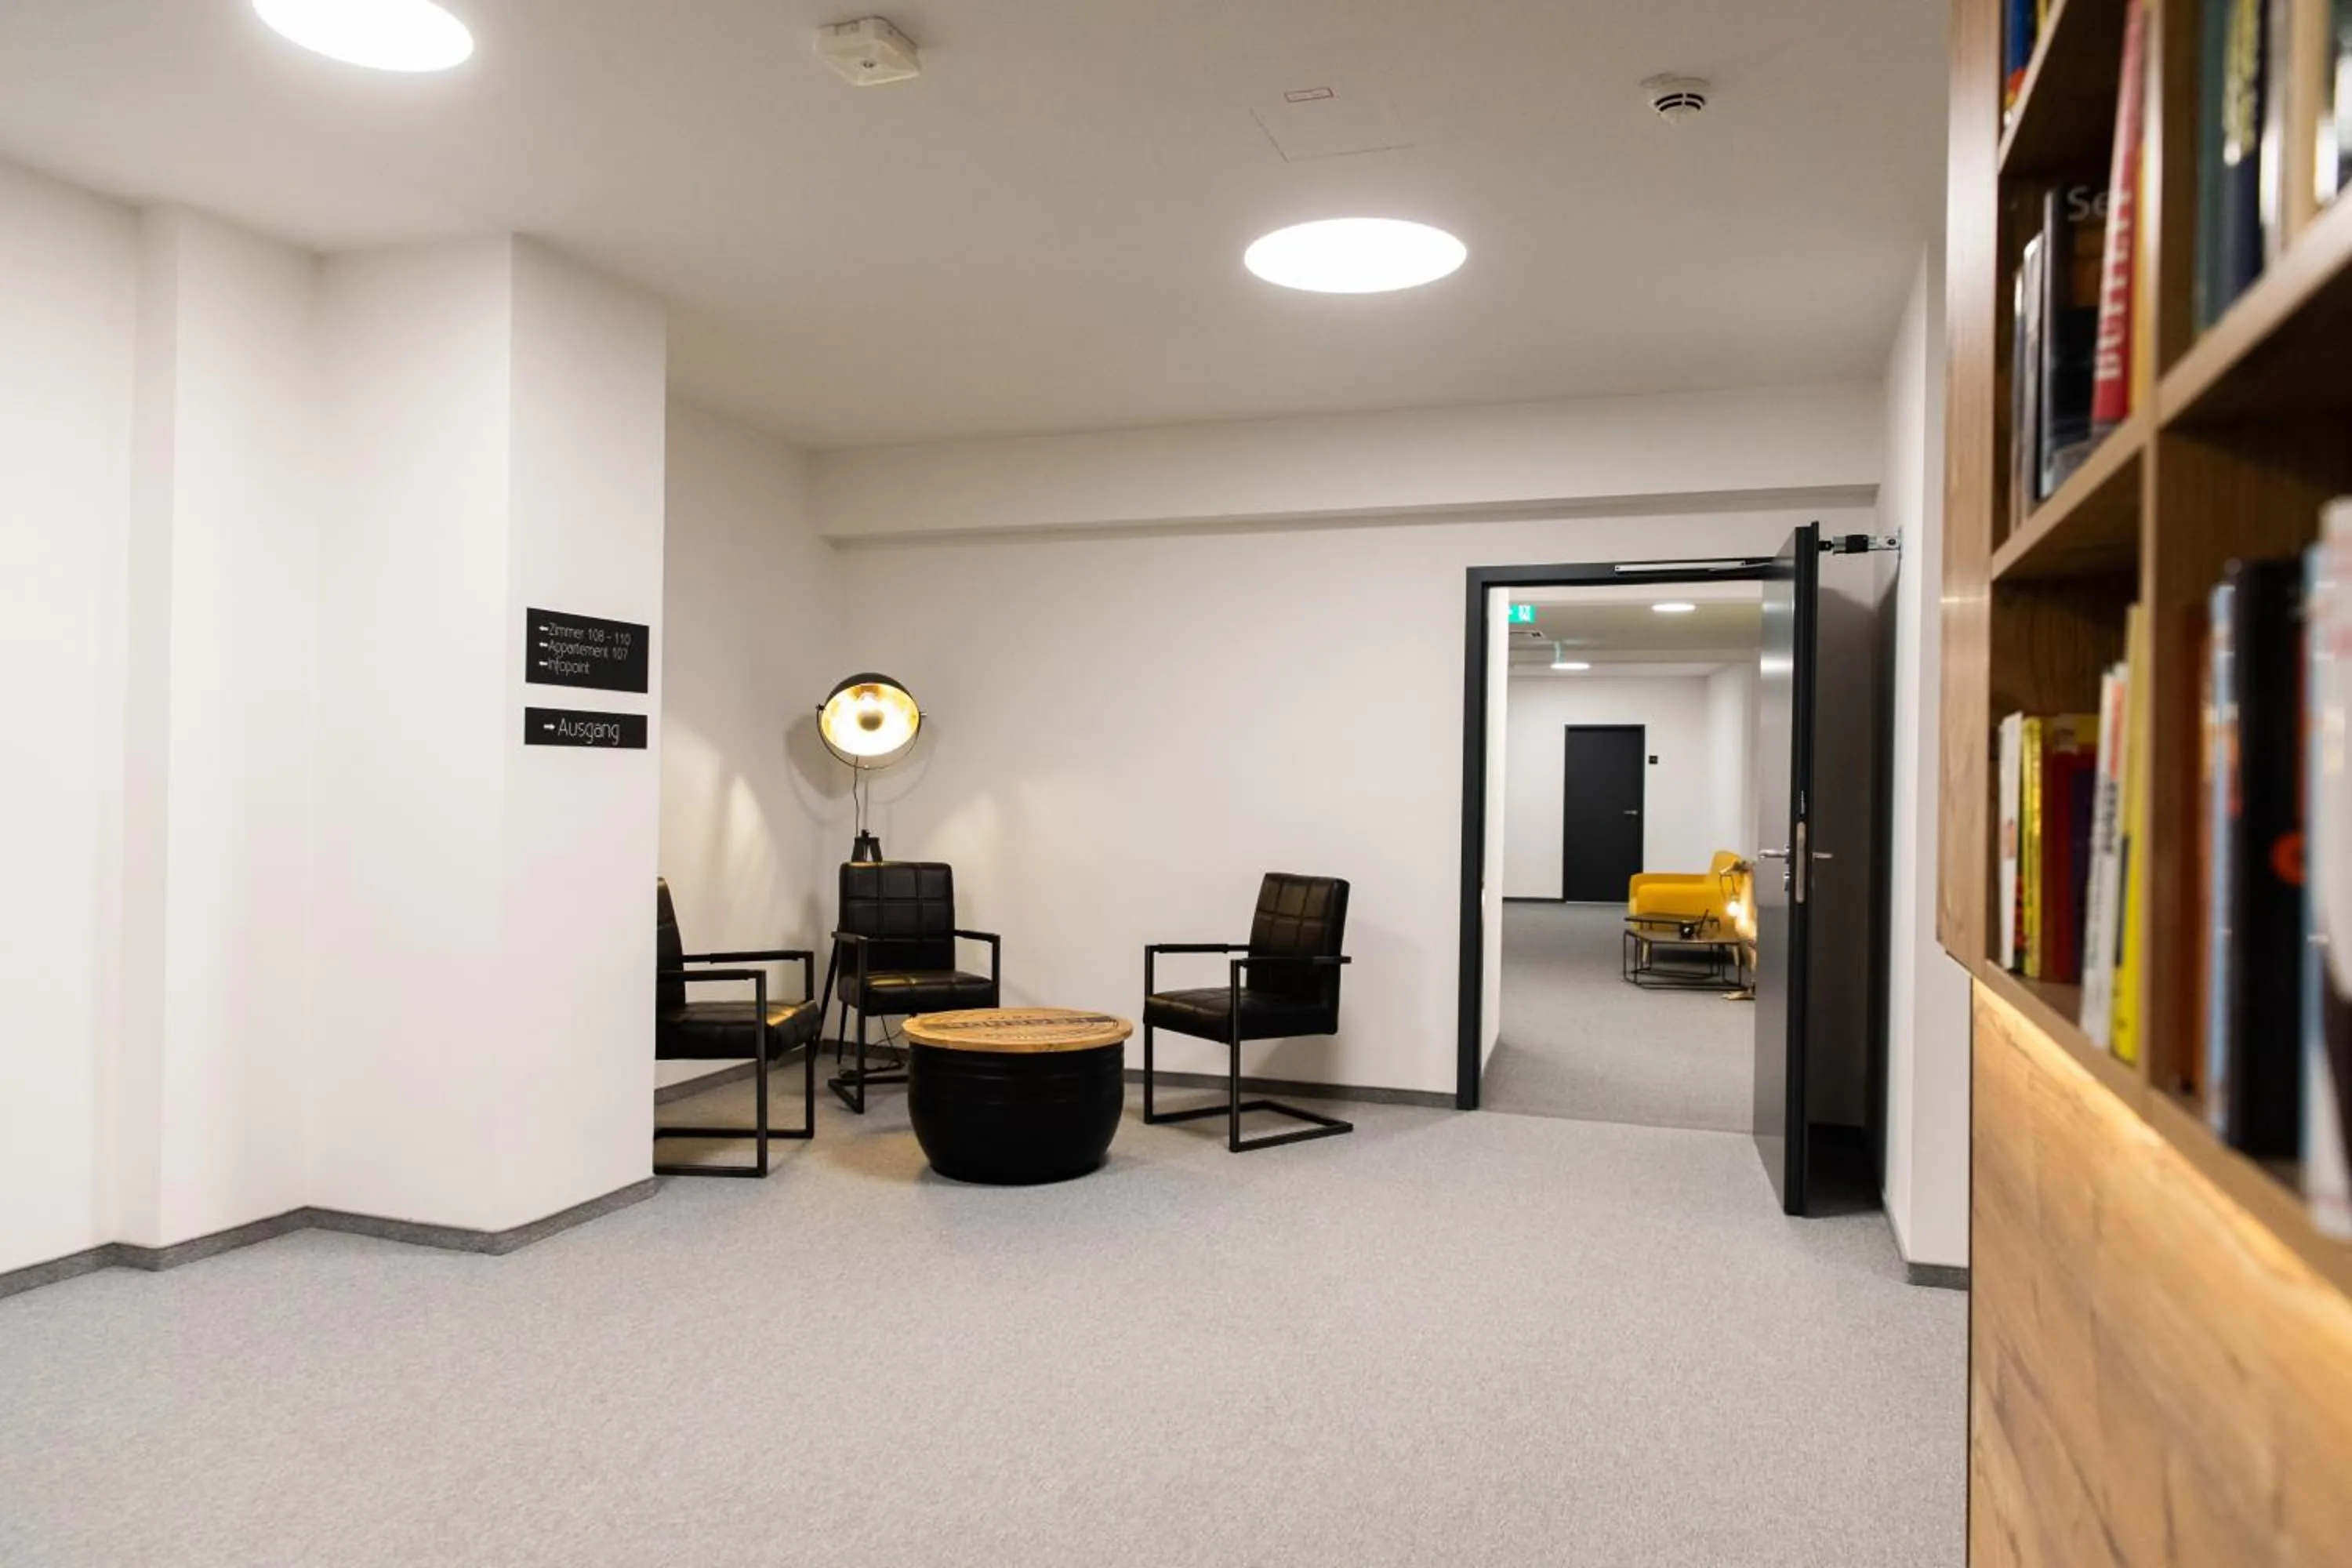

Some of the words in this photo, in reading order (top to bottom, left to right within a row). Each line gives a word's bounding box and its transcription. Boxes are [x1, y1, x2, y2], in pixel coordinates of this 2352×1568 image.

[549, 622, 584, 639] Zimmer
[588, 628, 604, 643] 108
[615, 632, 631, 647] 110
[612, 647, 628, 660] 107
[549, 658, 590, 676] Infopoint
[557, 717, 620, 746] Ausgang
